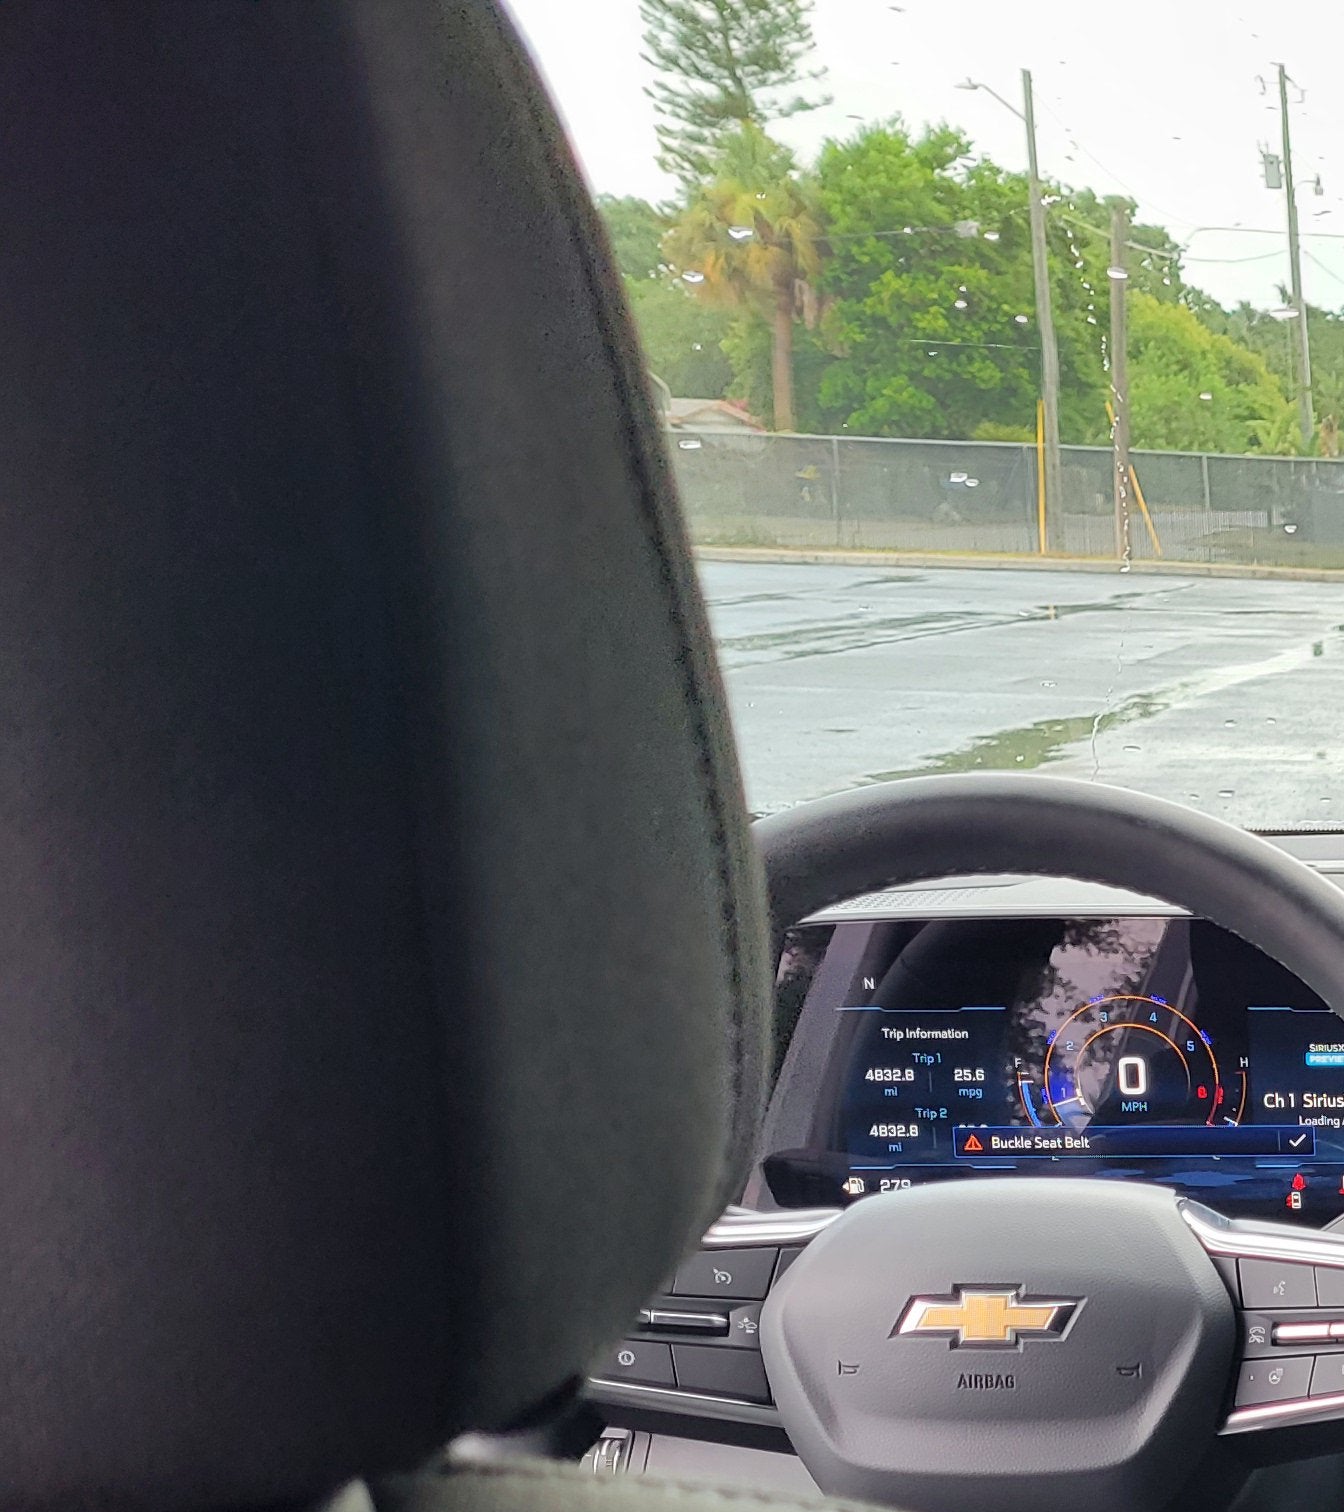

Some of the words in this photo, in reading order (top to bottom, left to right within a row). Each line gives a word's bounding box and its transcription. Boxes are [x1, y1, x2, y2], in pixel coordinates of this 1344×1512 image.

[864, 977, 875, 990] N
[1100, 1012, 1109, 1023] 3
[1149, 1012, 1158, 1023] 4
[881, 1027, 904, 1040] Trip
[906, 1027, 969, 1039] Information
[1066, 1041, 1074, 1051] 2
[1186, 1041, 1195, 1051] 5
[912, 1052, 934, 1065] Trip
[936, 1053, 942, 1063] 1
[1014, 1057, 1023, 1069] F
[1240, 1057, 1249, 1068] H
[865, 1069, 915, 1081] 4832.8
[954, 1069, 985, 1081] 25.6
[1118, 1057, 1147, 1095] 0
[884, 1087, 898, 1097] mi
[958, 1088, 983, 1099] mpg
[1263, 1092, 1285, 1108] Ch
[1289, 1093, 1295, 1108] 1
[1121, 1101, 1148, 1112] MPH
[915, 1107, 938, 1120] Trip
[939, 1107, 948, 1118] 2
[1299, 1115, 1340, 1128] Loading
[870, 1125, 919, 1137] 4832.8
[888, 1142, 902, 1152] mi
[991, 1136, 1032, 1149] Buckle
[1034, 1136, 1062, 1149] Seat
[1064, 1136, 1090, 1149] Belt
[957, 1373, 1016, 1389] AIRBAG
